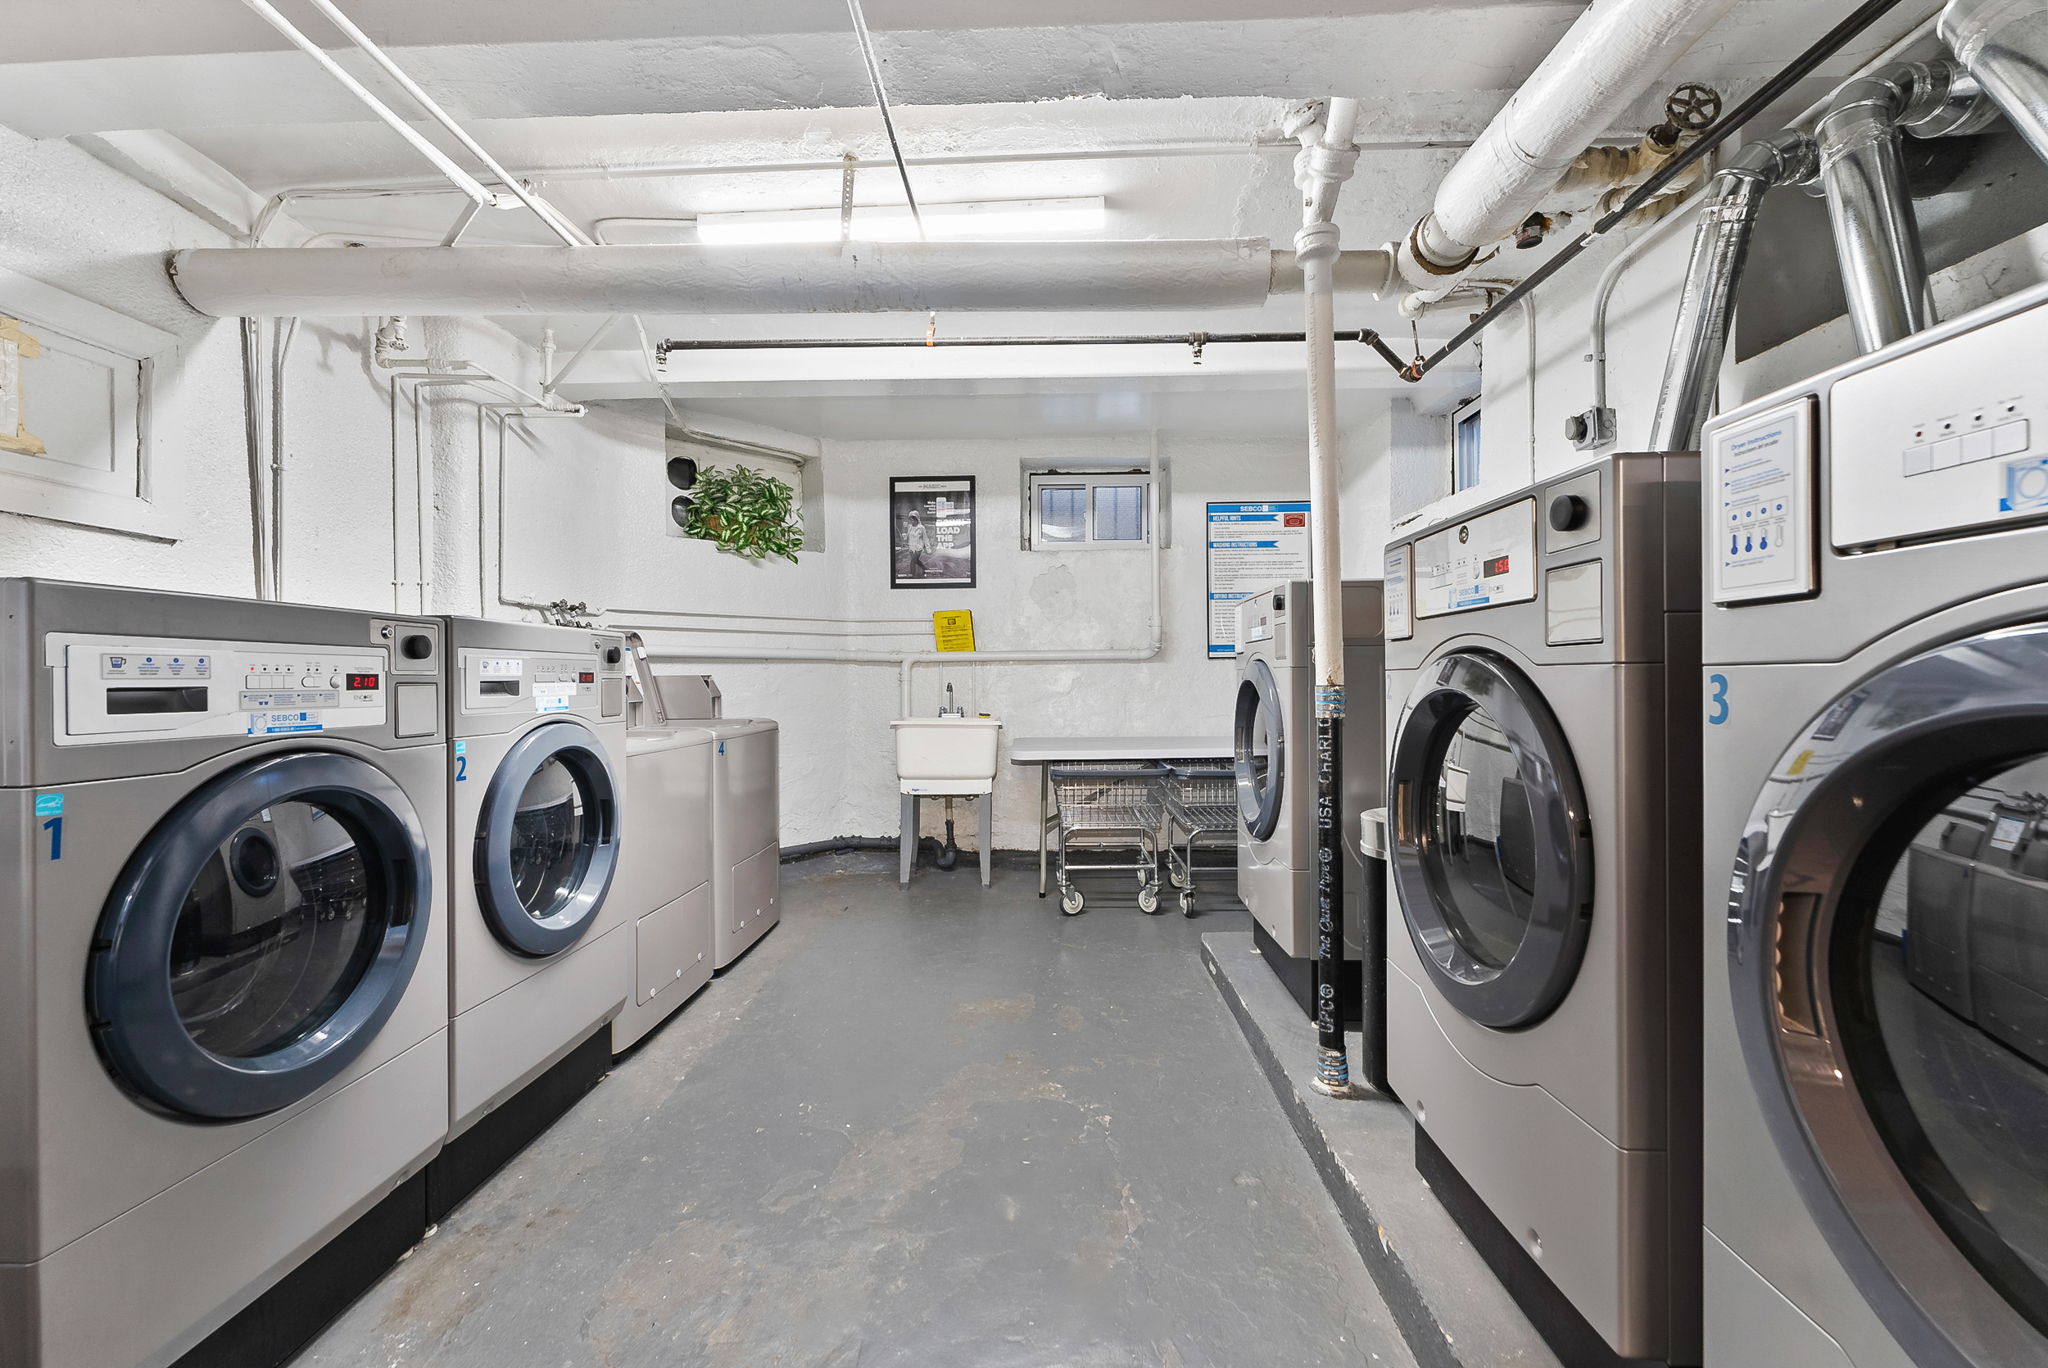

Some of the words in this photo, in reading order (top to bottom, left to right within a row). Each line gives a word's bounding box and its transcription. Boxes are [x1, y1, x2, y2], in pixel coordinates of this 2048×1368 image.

[936, 534, 953, 542] THE
[1708, 674, 1729, 726] 3
[271, 713, 299, 722] SEBCO
[717, 742, 725, 756] 4
[455, 756, 467, 782] 2
[1318, 796, 1333, 829] USA
[43, 817, 62, 861] 1
